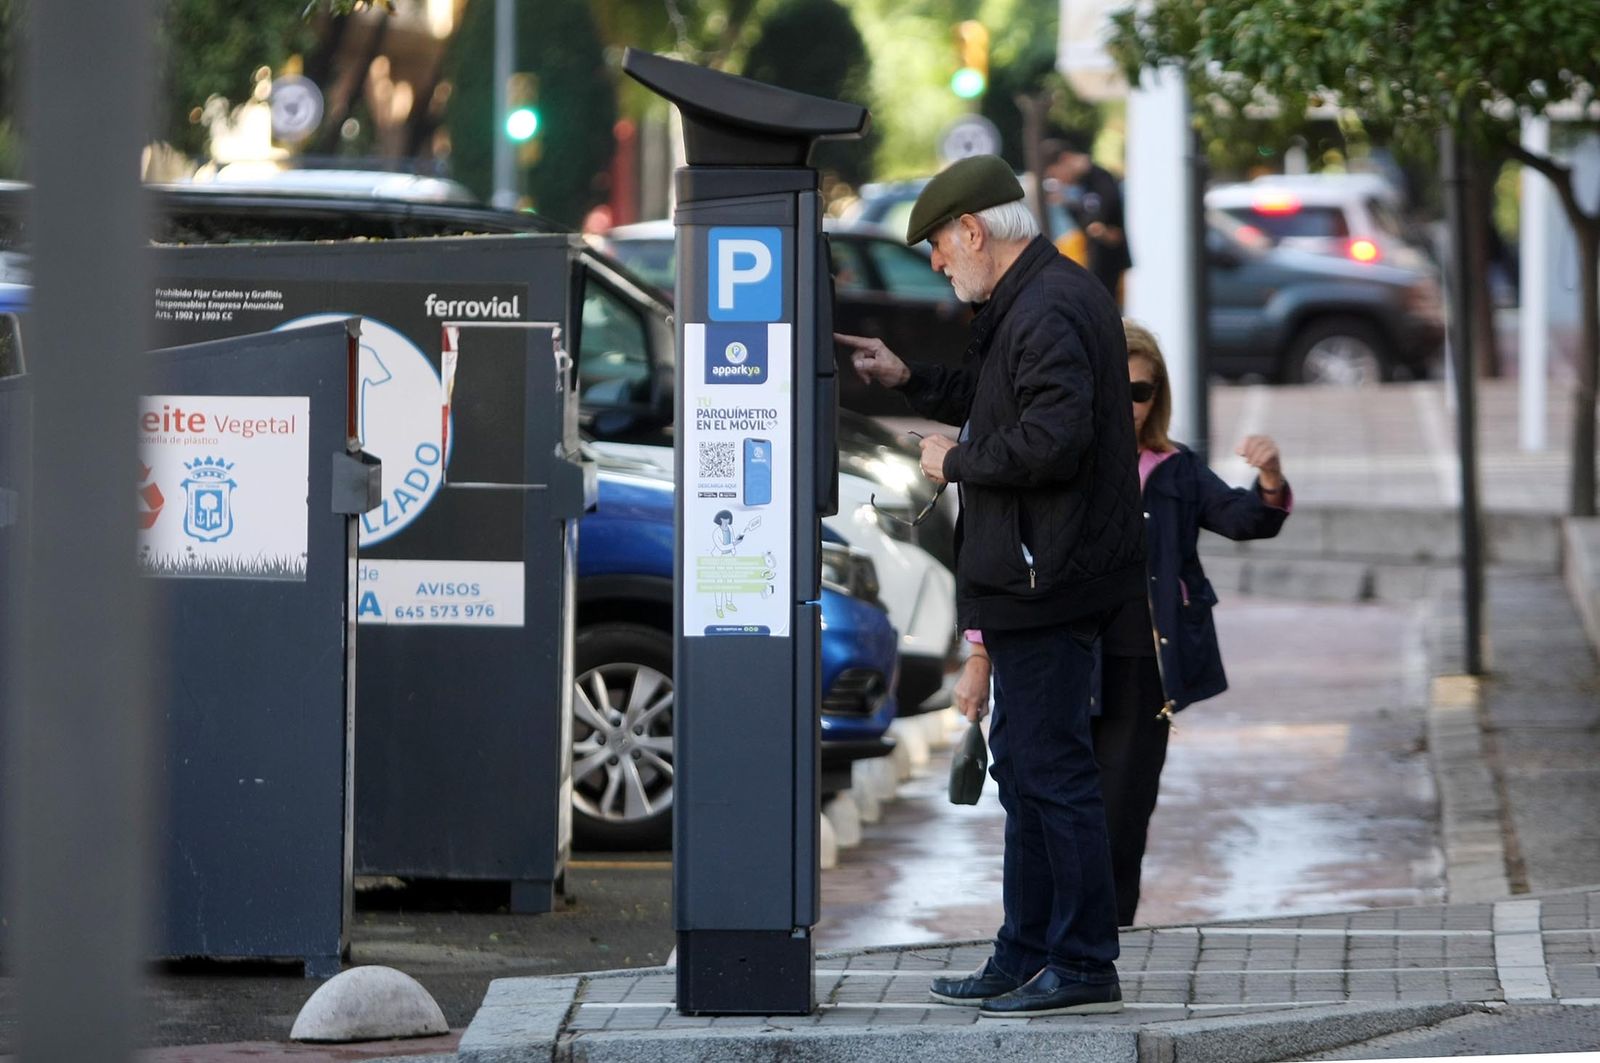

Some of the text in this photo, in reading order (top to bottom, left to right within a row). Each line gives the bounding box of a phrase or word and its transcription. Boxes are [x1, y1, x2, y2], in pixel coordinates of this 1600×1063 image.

[717, 239, 772, 310] P
[155, 288, 282, 300] Prohibido Fijar Carteles y Graffitis
[155, 299, 284, 311] Responsables Empresa Anunciada
[424, 293, 520, 318] ferrovial
[175, 311, 193, 320] 1902
[195, 312, 200, 322] y
[202, 311, 220, 320] 1903
[222, 312, 233, 320] CC
[712, 364, 760, 377] apparkya
[696, 405, 778, 420] PARQUÍMETRO
[214, 415, 295, 438] Vegetal
[696, 420, 711, 431] EN
[714, 420, 727, 431] EL
[170, 436, 182, 446] de
[183, 436, 218, 447] plástico
[416, 582, 481, 597] AVISOS
[395, 604, 495, 619] 645 573 976
